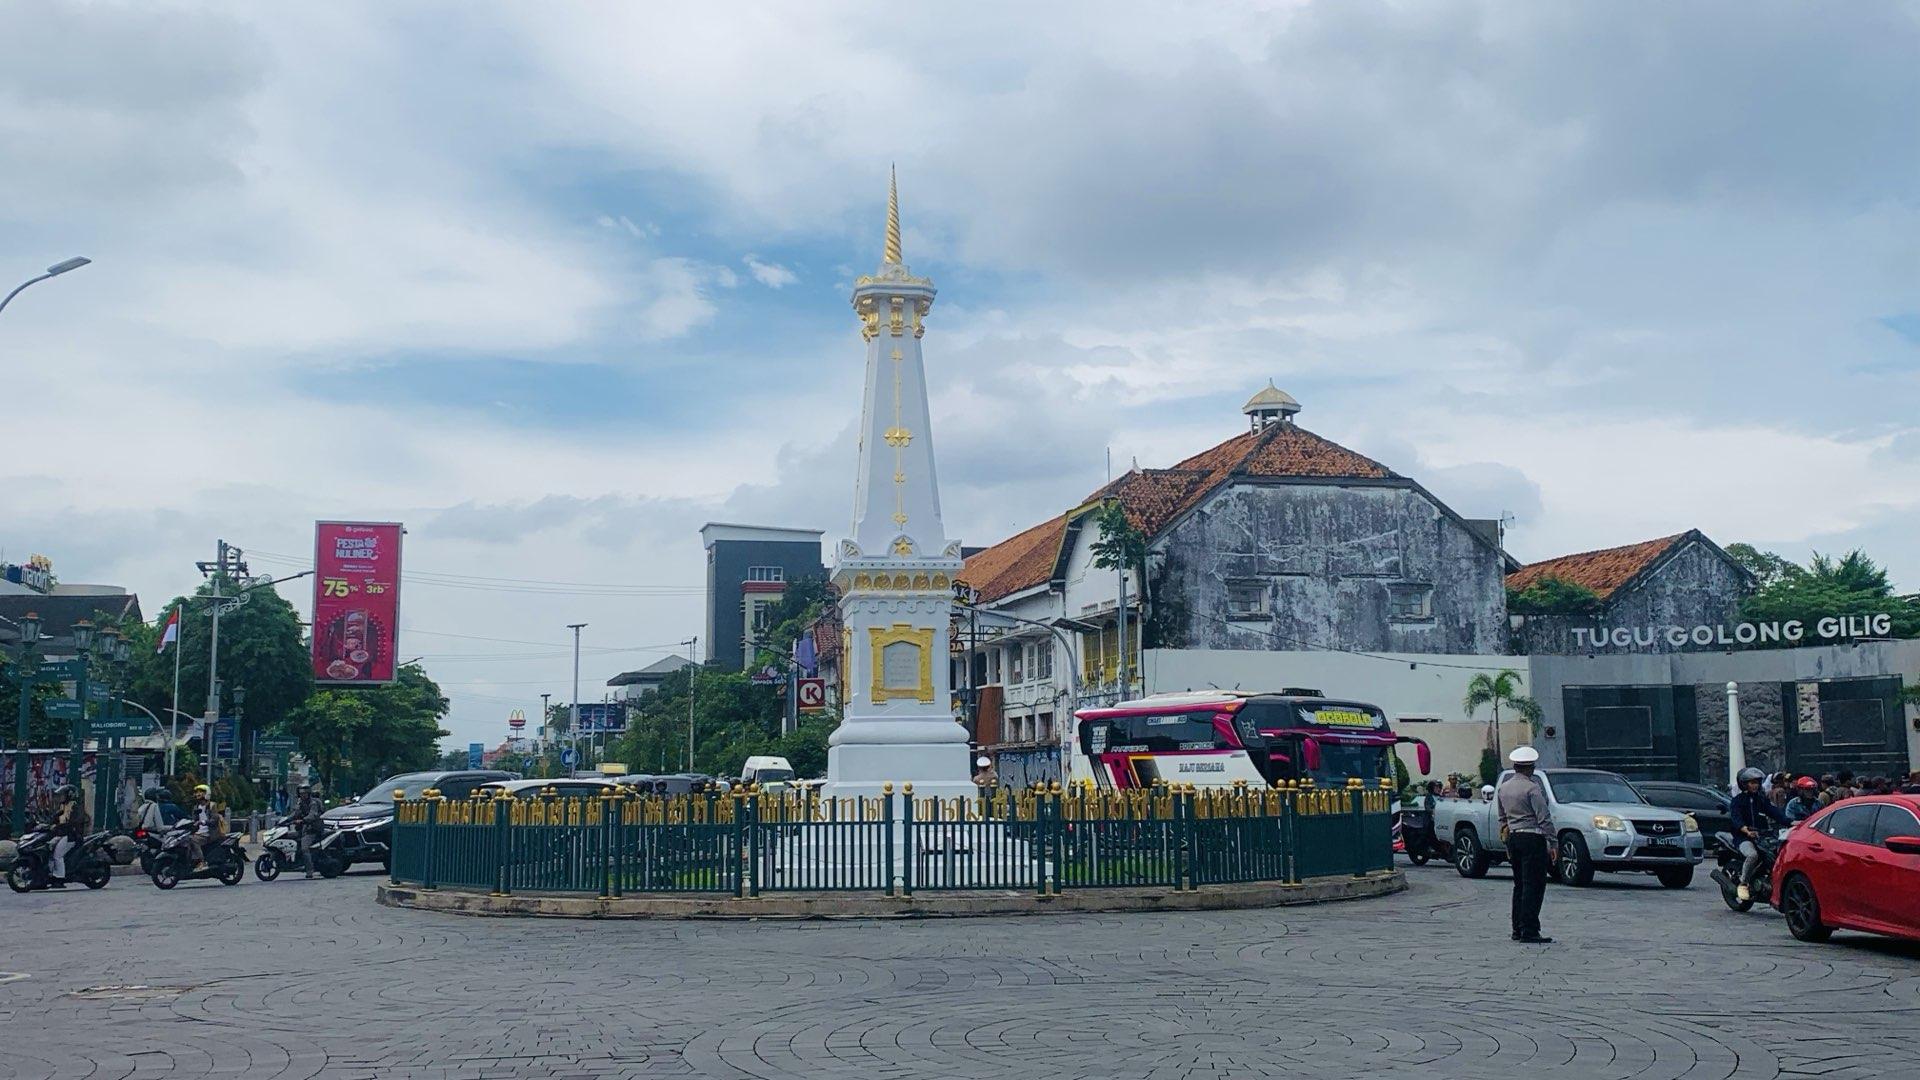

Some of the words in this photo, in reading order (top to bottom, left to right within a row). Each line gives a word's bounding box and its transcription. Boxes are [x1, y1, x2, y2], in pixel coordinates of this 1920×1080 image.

[337, 539, 365, 549] PESTA
[366, 585, 384, 594] 3rb
[1571, 627, 1654, 647] TUGU
[1667, 620, 1804, 646] GOLONG
[1817, 613, 1892, 638] GILIG
